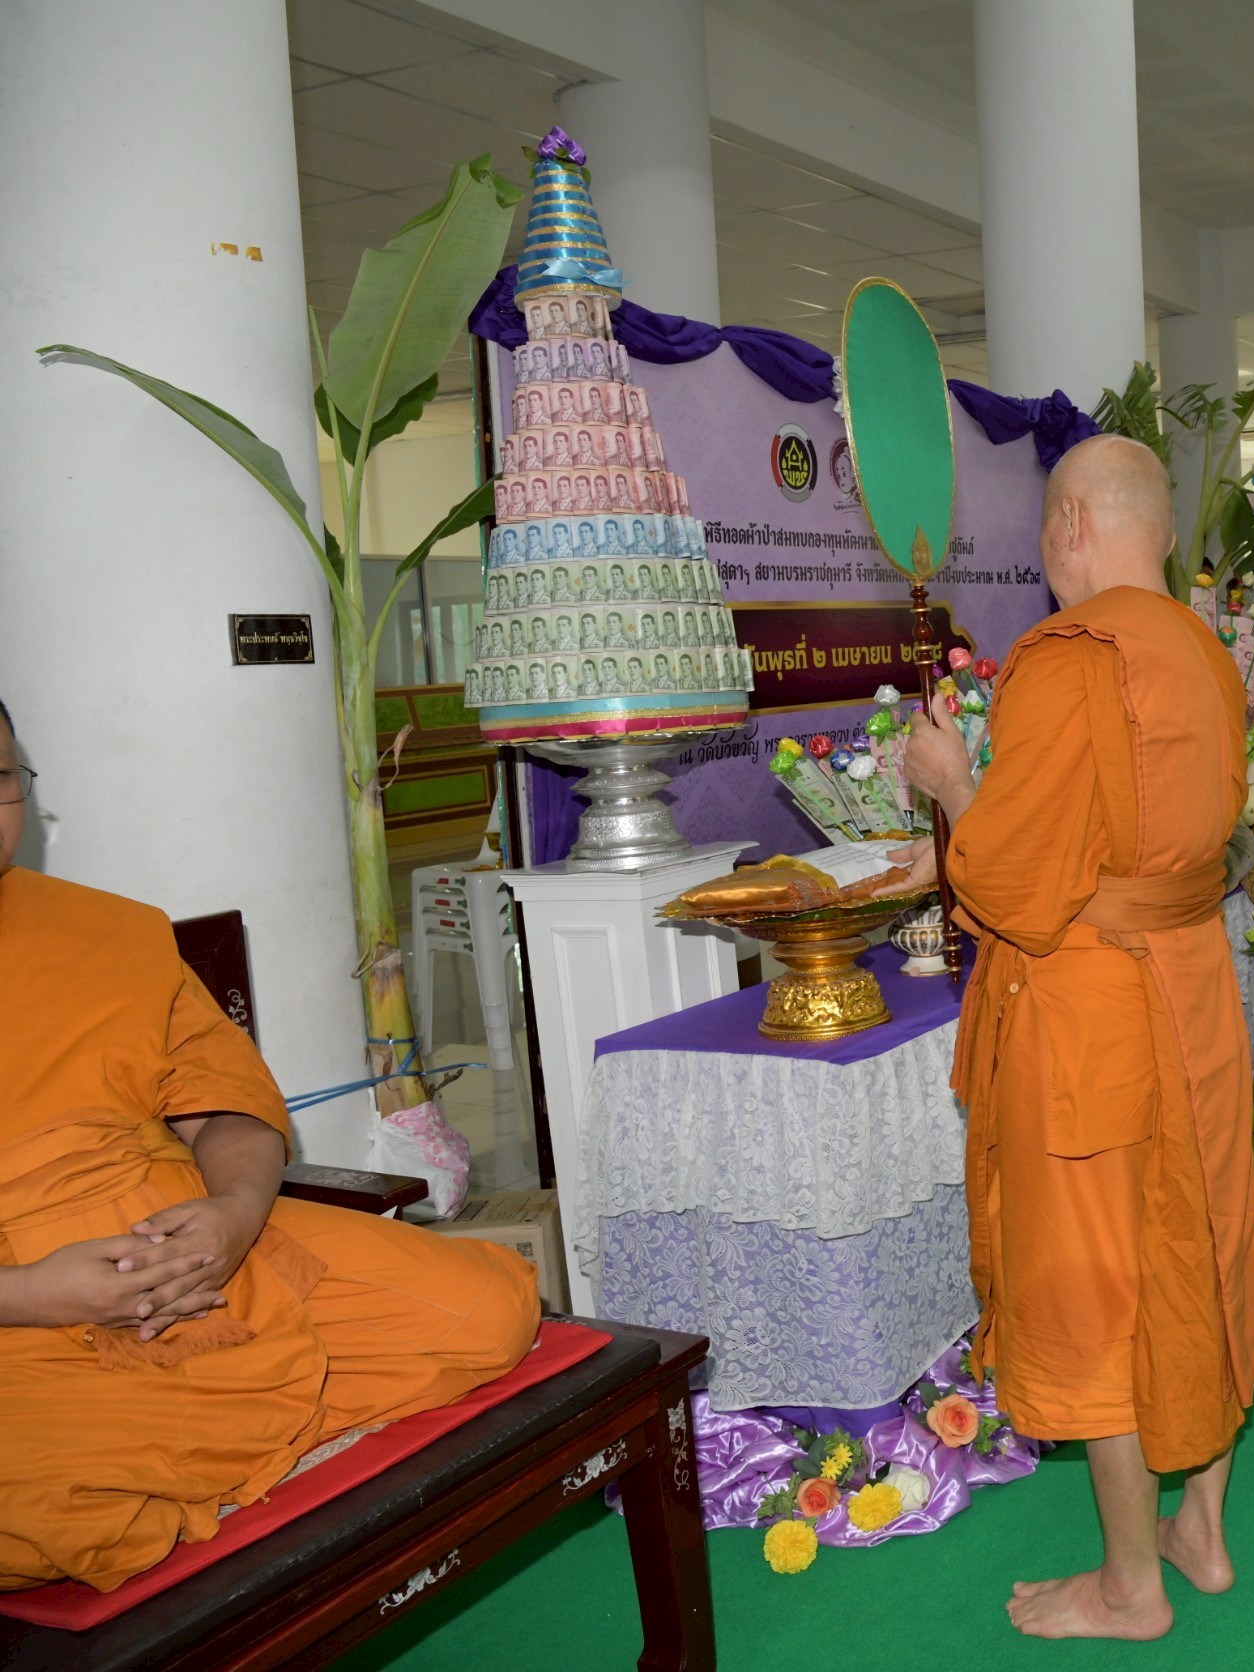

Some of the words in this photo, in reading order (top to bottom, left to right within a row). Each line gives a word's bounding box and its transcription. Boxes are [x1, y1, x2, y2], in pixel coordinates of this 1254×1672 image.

[812, 648, 827, 668] ๒
[832, 645, 891, 667] เมษายน
